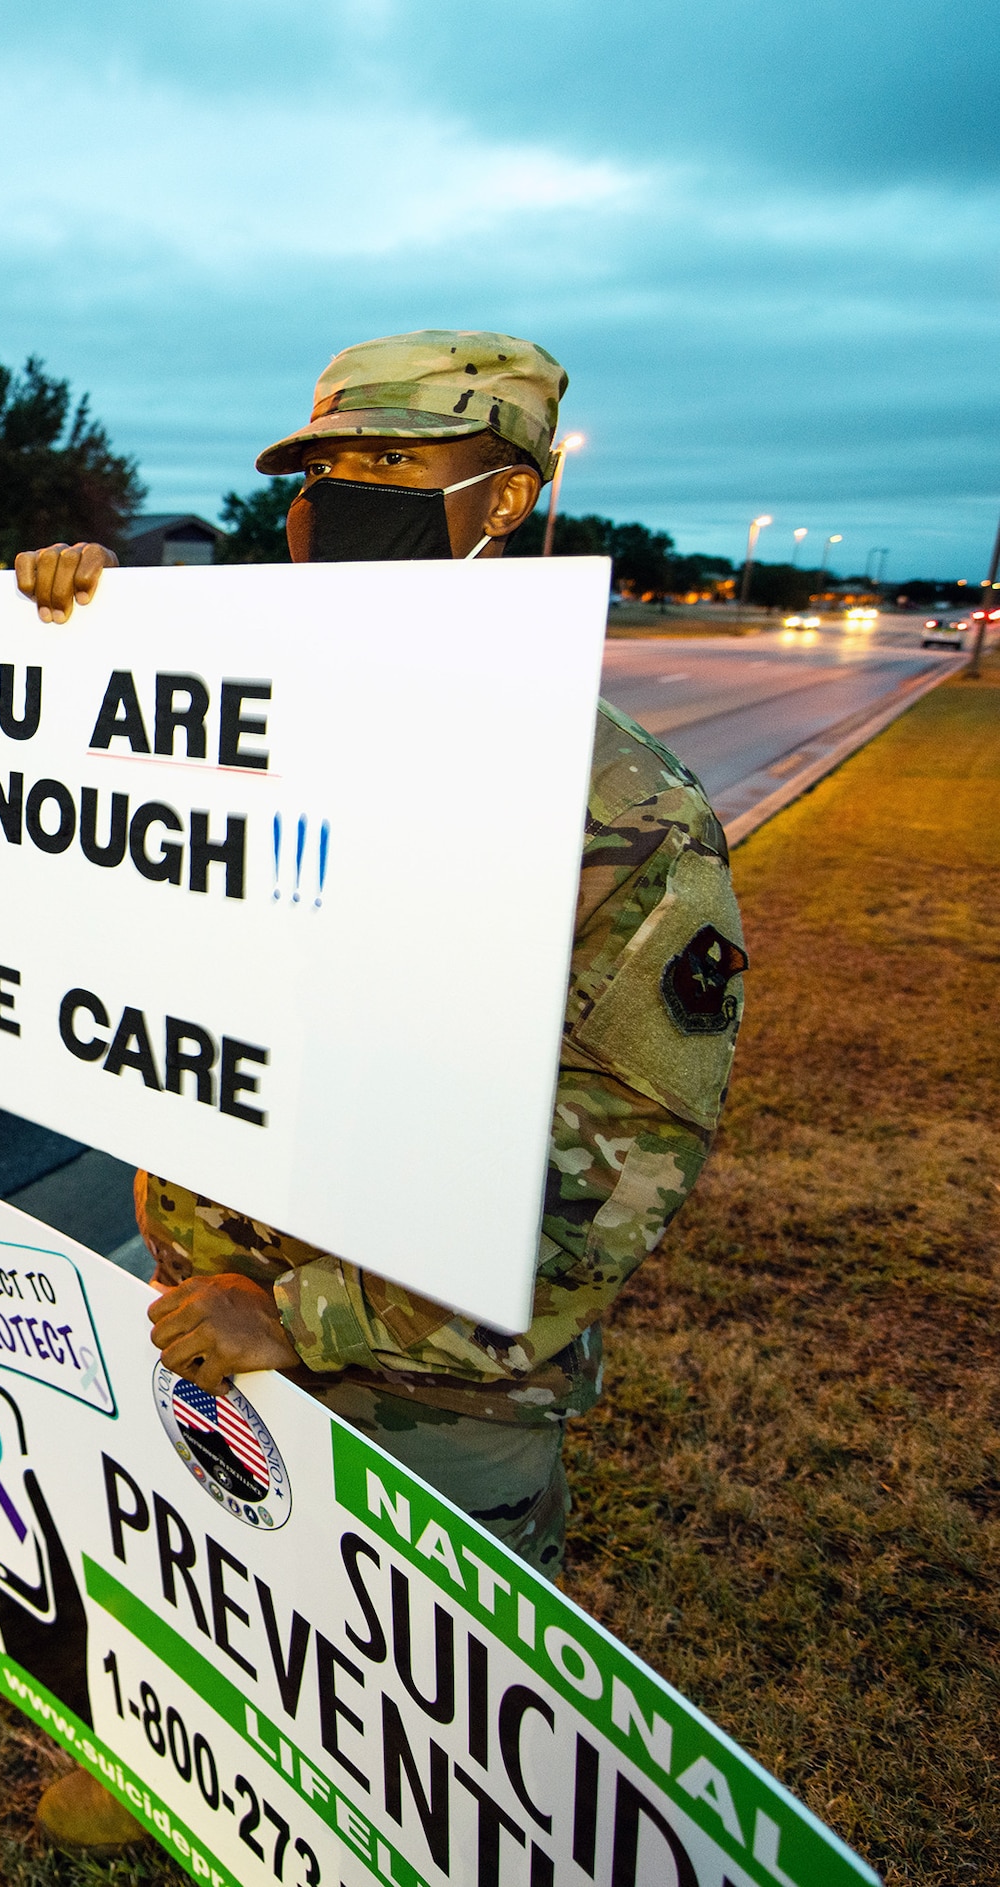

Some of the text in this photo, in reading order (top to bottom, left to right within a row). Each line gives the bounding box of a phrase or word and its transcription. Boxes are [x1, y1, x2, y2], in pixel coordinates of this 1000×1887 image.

[88, 669, 273, 770] ARE
[58, 988, 270, 1128] CARE
[24, 1271, 56, 1305] TO
[233, 1395, 284, 1484] ANTONIO
[102, 1649, 346, 1887] 1-800-273
[339, 1531, 736, 1887] SUICID
[365, 1466, 800, 1887] NATIONAL
[2, 1666, 230, 1887] www.suicidepr
[244, 1702, 424, 1887] LIFEL
